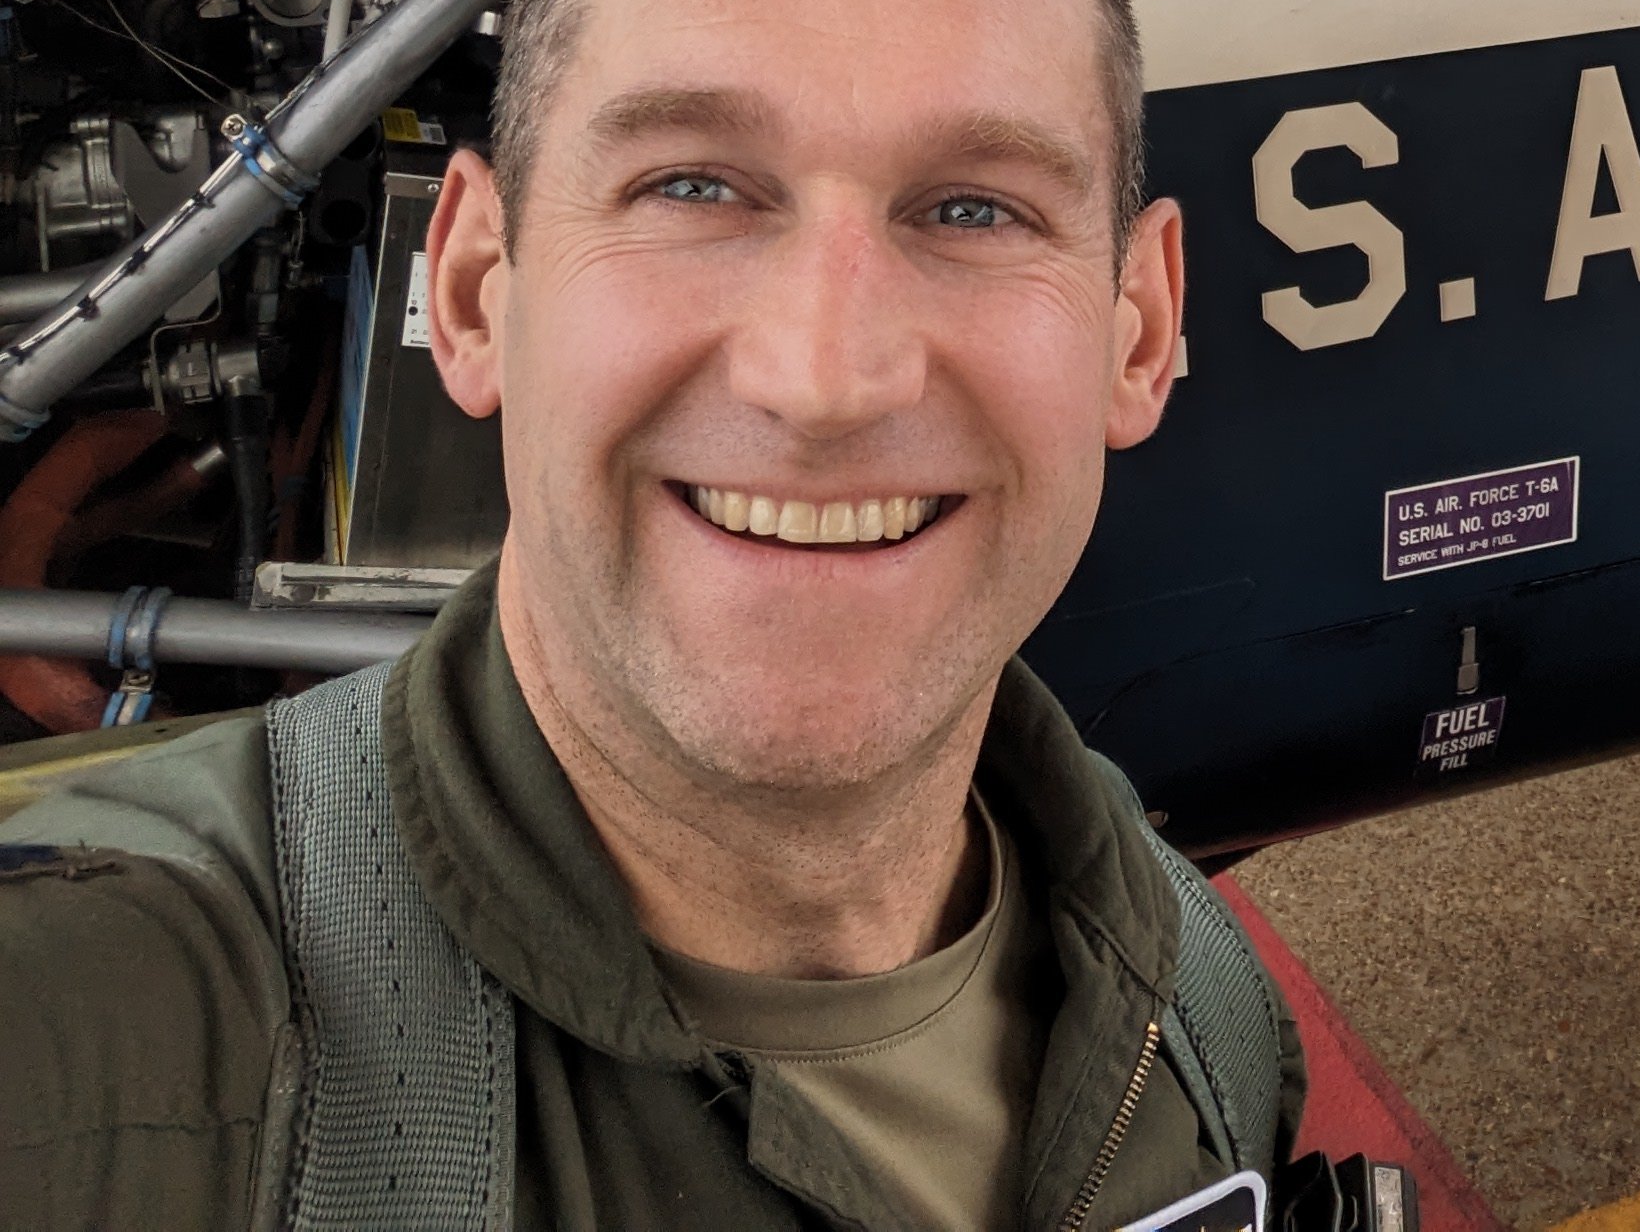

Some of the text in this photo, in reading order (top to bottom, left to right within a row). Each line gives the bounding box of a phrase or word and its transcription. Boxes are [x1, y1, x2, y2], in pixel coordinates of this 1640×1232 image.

[1399, 502, 1428, 521] U.S.
[1470, 484, 1519, 507] FORCE
[1525, 476, 1559, 496] T-6A
[1399, 502, 1550, 546] SERIAL NO. 03-3701
[1397, 549, 1438, 567] SERVICE
[1441, 544, 1464, 558] WITH
[1492, 534, 1517, 548] FUEL
[1435, 704, 1489, 738] FUEL
[1422, 729, 1496, 761] PRESSURE
[1440, 754, 1468, 771] FILL
